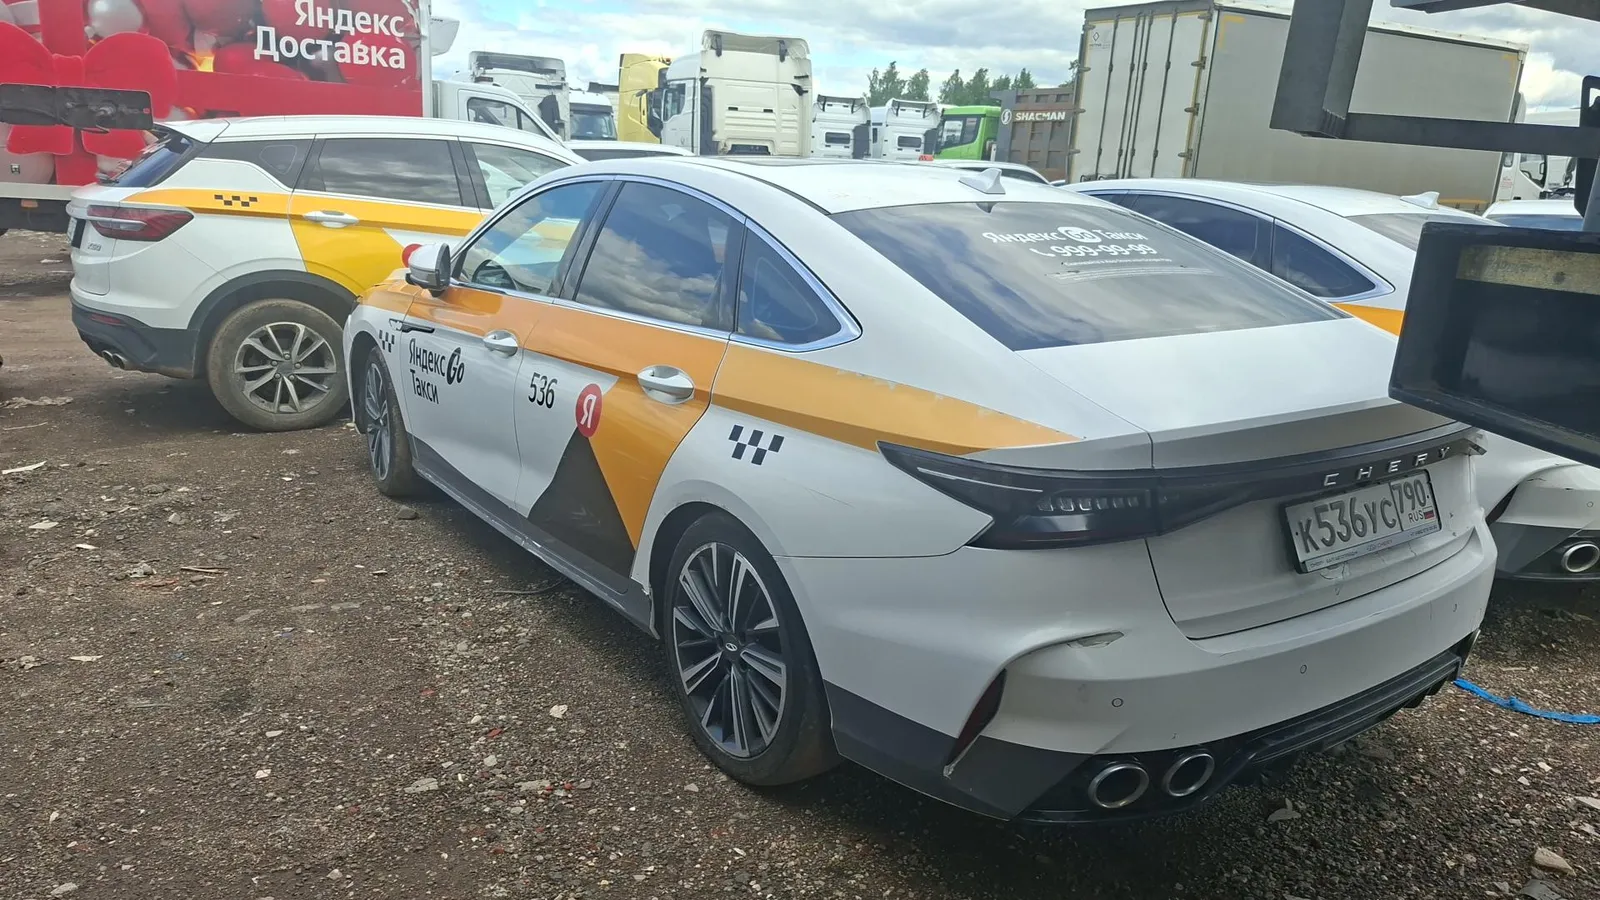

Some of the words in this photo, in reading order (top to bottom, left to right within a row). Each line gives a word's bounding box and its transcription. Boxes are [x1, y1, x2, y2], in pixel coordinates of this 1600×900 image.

[294, 0, 405, 38] Яндекс
[253, 25, 406, 70] Доставка
[1015, 111, 1066, 121] SHACMAN
[982, 231, 1067, 244] Яндекс
[1092, 229, 1149, 241] Такси
[1050, 244, 1158, 257] 999-99-99
[408, 337, 446, 377] Яндекс
[446, 346, 465, 386] Go
[409, 368, 440, 405] Такси
[527, 371, 558, 409] 536
[580, 393, 598, 429] Я
[1323, 446, 1450, 487] CHERY
[1391, 478, 1427, 514] 790
[1408, 509, 1424, 522] RUS
